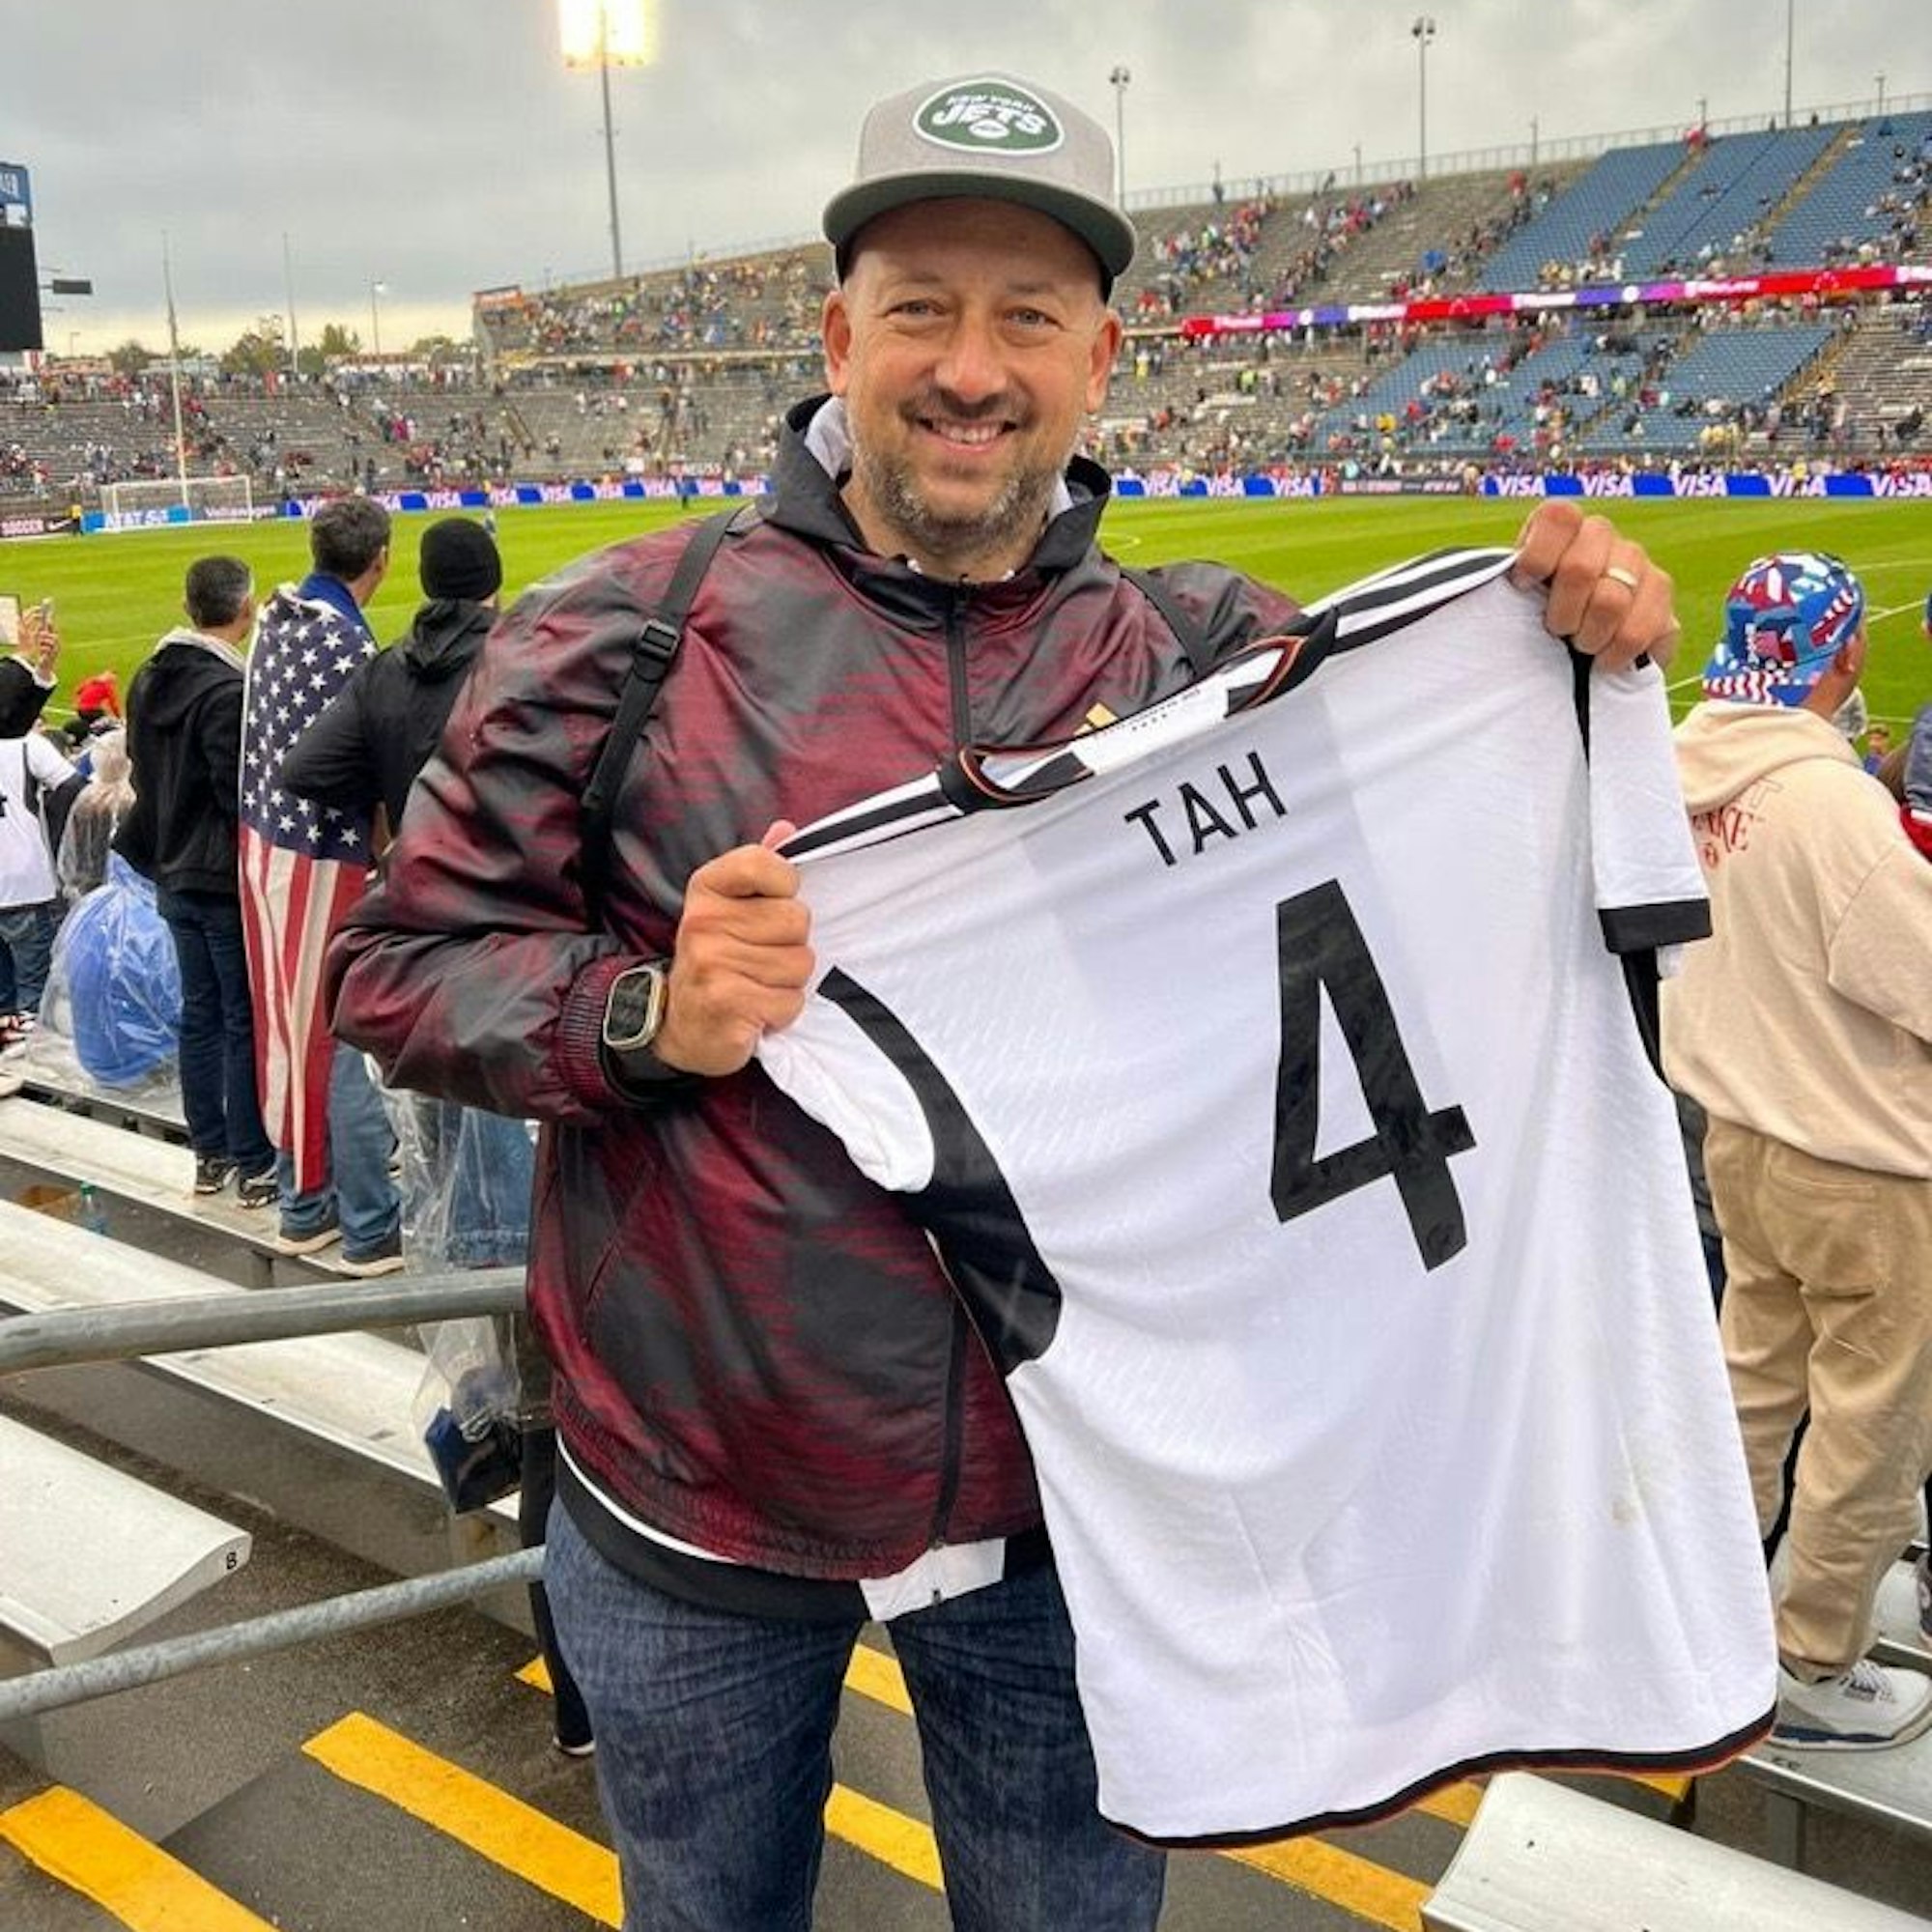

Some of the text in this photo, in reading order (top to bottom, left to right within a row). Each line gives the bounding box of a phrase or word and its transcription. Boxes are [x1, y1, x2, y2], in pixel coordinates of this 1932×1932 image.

[931, 101, 1048, 135] JETS
[1207, 472, 1245, 496] VISA
[1272, 474, 1315, 496] VISA
[1493, 473, 1546, 496] VISA
[1577, 473, 1634, 496] VISA
[1672, 473, 1728, 496] VISA
[1869, 473, 1932, 496] VISA
[426, 490, 461, 510] VISA
[1123, 752, 1288, 867] TAH
[1270, 877, 1477, 1273] 4
